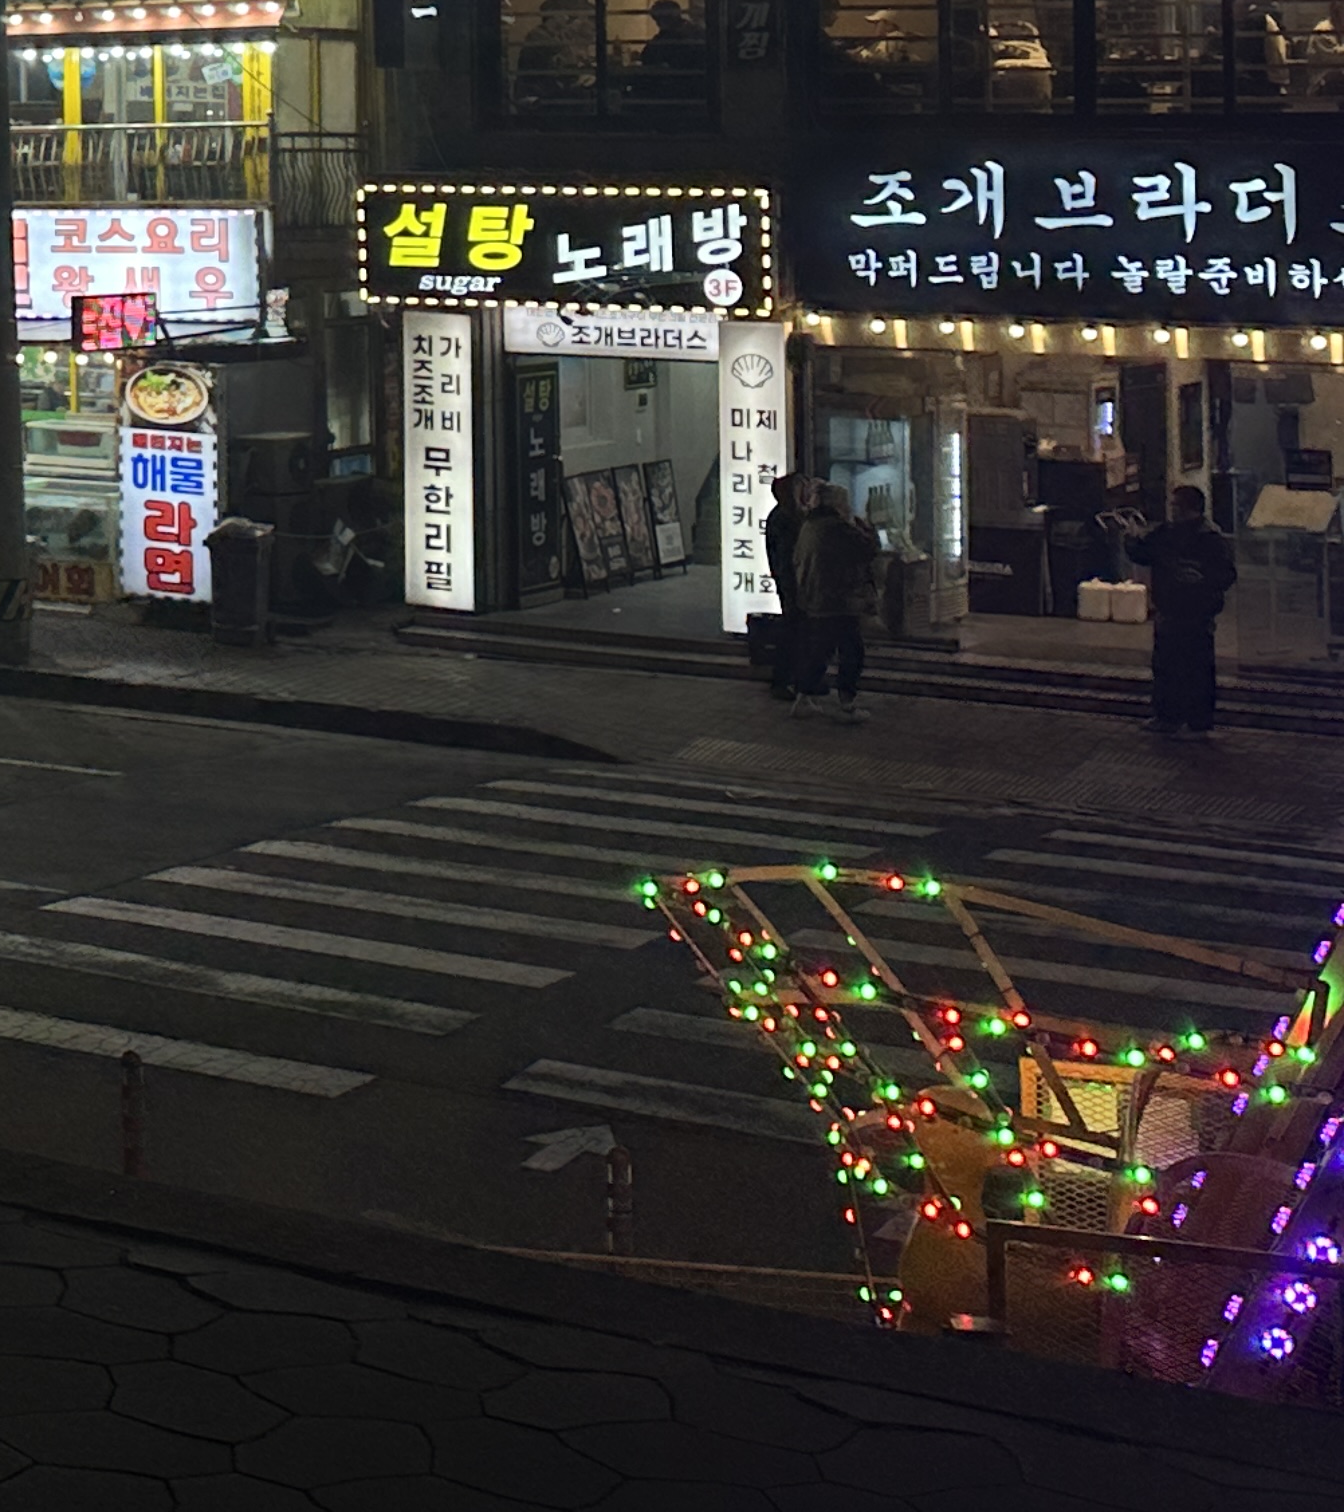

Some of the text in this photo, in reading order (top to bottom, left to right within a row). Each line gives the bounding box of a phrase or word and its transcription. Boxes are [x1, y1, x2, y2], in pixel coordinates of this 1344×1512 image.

[52, 216, 230, 263] 코스요리
[382, 202, 748, 285] 설탕 노래방
[849, 159, 1344, 245] 조개브라더
[52, 265, 234, 308] 왕새우
[418, 271, 502, 295] sugar
[708, 278, 739, 298] 3F
[848, 249, 1091, 291] 막퍼드립니다
[571, 326, 709, 351] 조개브라더스
[412, 334, 436, 432] 치즈조개
[439, 335, 463, 433] 가리비
[130, 453, 205, 496] 해물
[528, 426, 549, 548] 노래방
[729, 407, 755, 594] 미나리키조개
[144, 500, 198, 595] 라면
[423, 446, 454, 592] 무한리필
